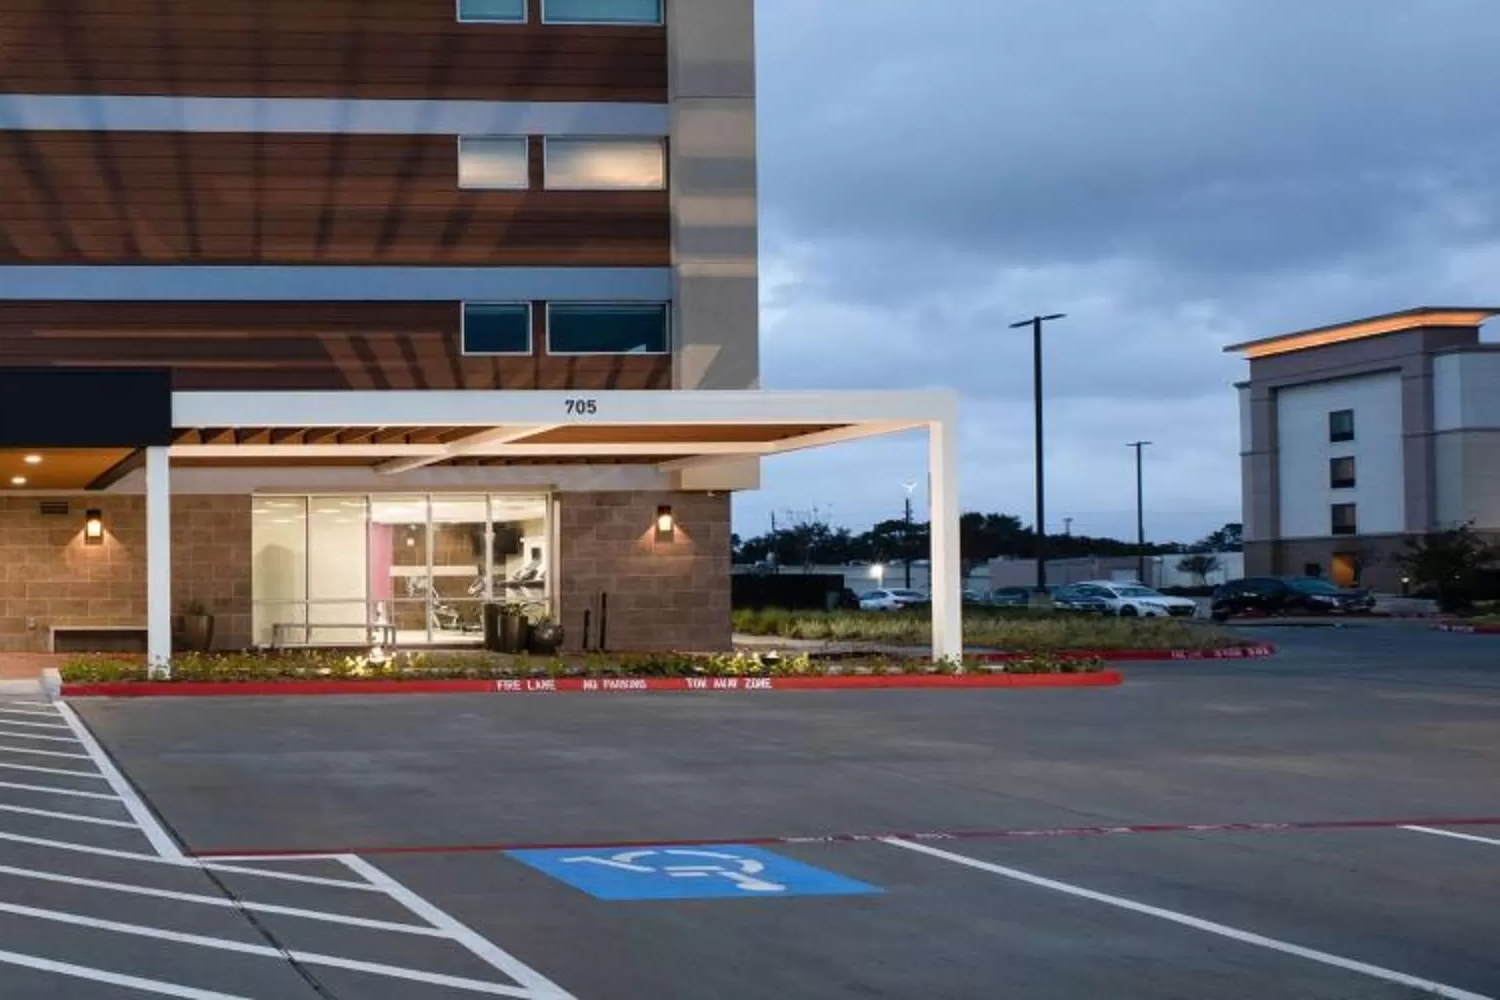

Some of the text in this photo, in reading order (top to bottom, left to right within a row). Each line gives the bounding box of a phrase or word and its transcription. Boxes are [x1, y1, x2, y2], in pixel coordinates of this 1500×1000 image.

[564, 398, 597, 415] 705
[495, 679, 521, 691] FIRE
[526, 679, 557, 691] LANE
[602, 678, 648, 690] PARKING
[744, 677, 773, 689] ZONE
